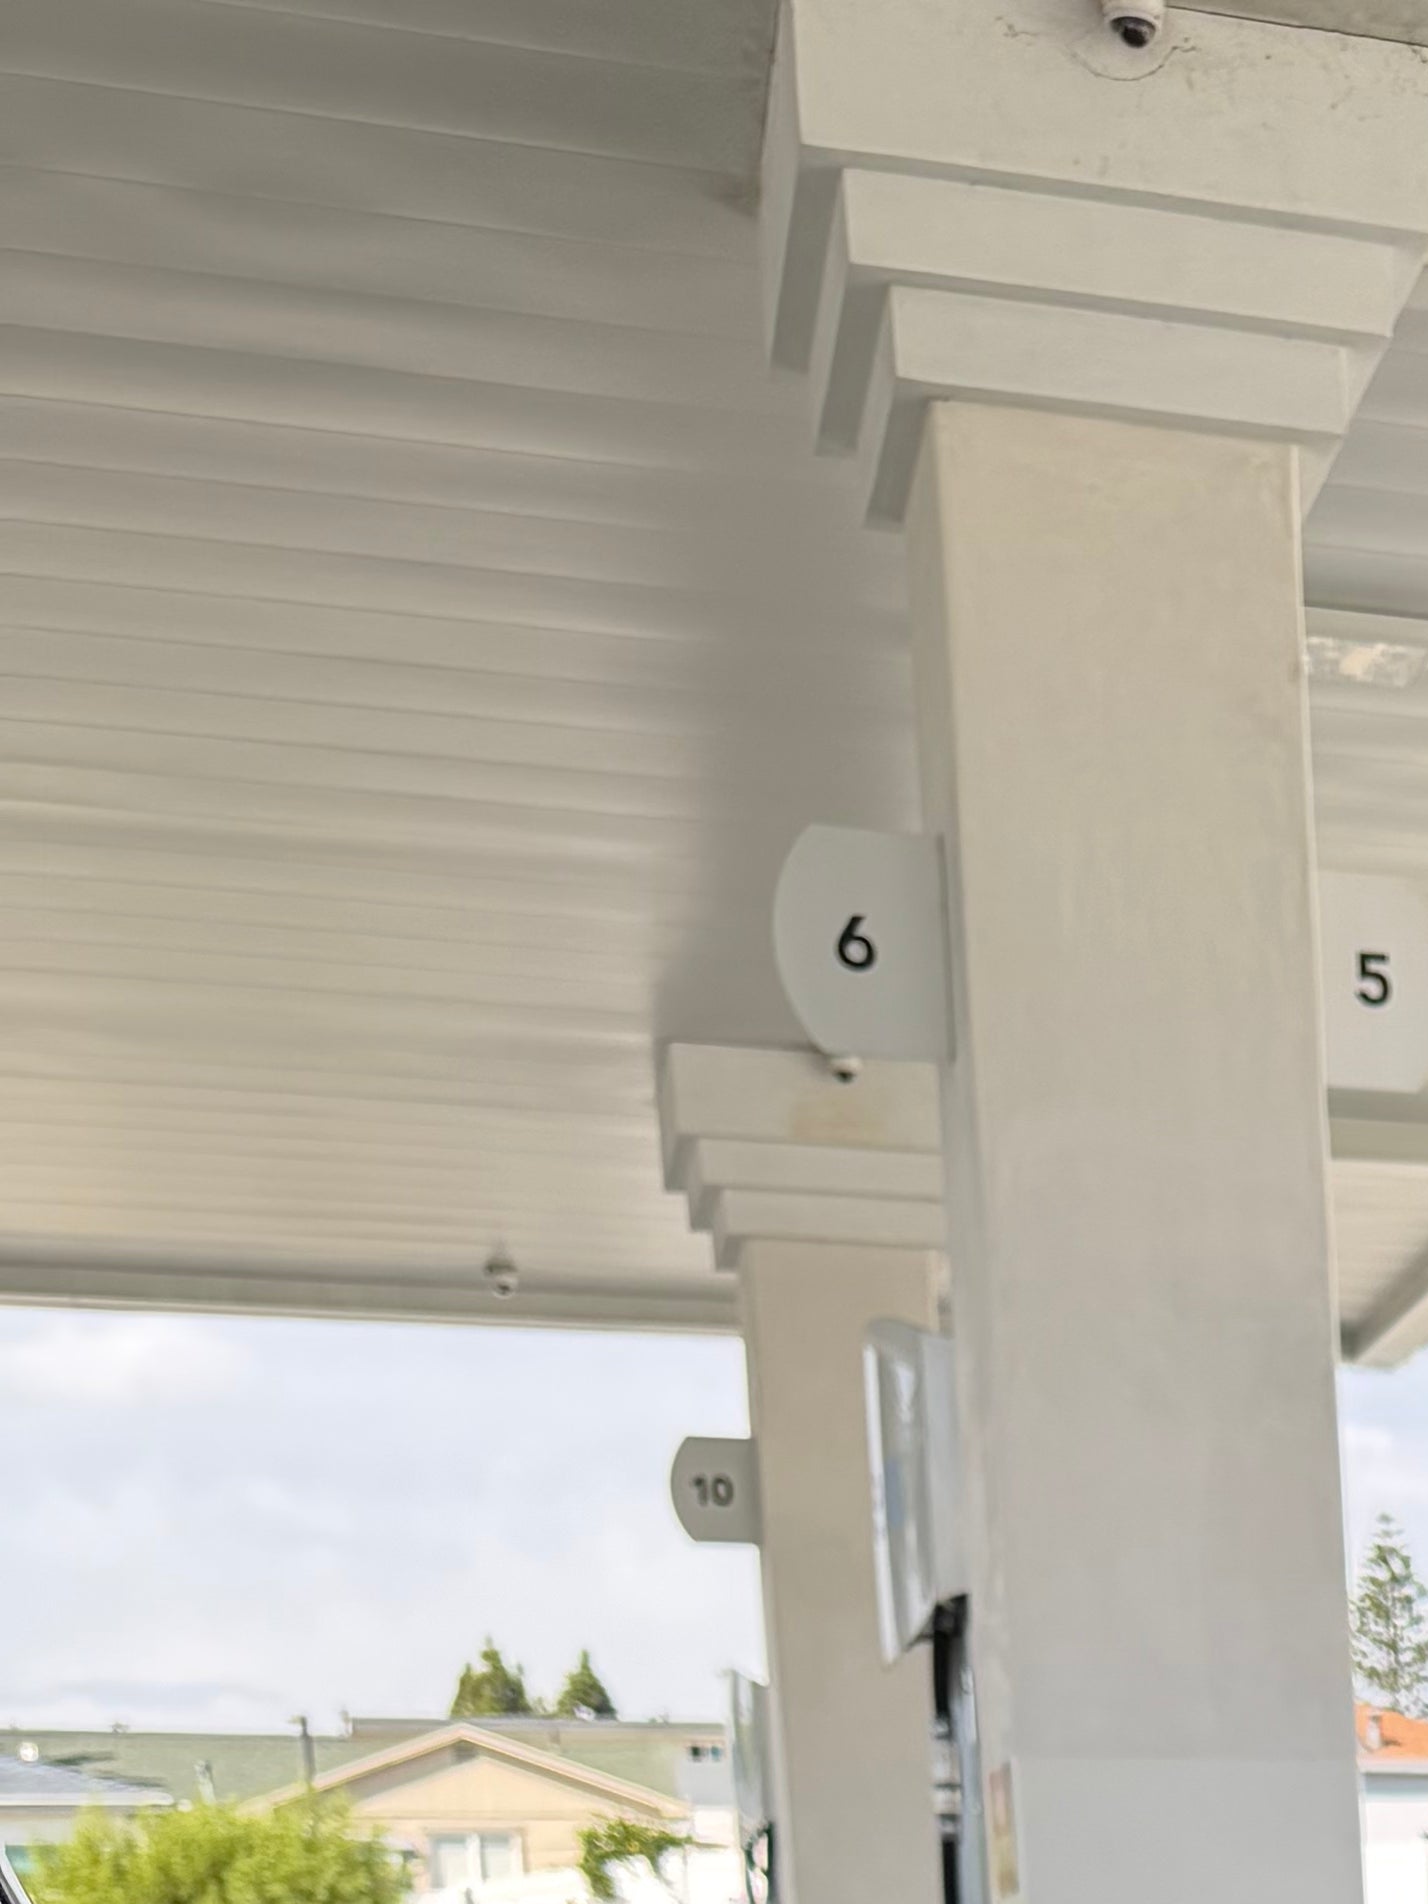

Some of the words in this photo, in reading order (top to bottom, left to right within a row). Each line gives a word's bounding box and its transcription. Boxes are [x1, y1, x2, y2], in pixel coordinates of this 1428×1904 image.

[836, 914, 878, 972] 6
[1354, 950, 1393, 1008] 5
[692, 1474, 734, 1507] 10
